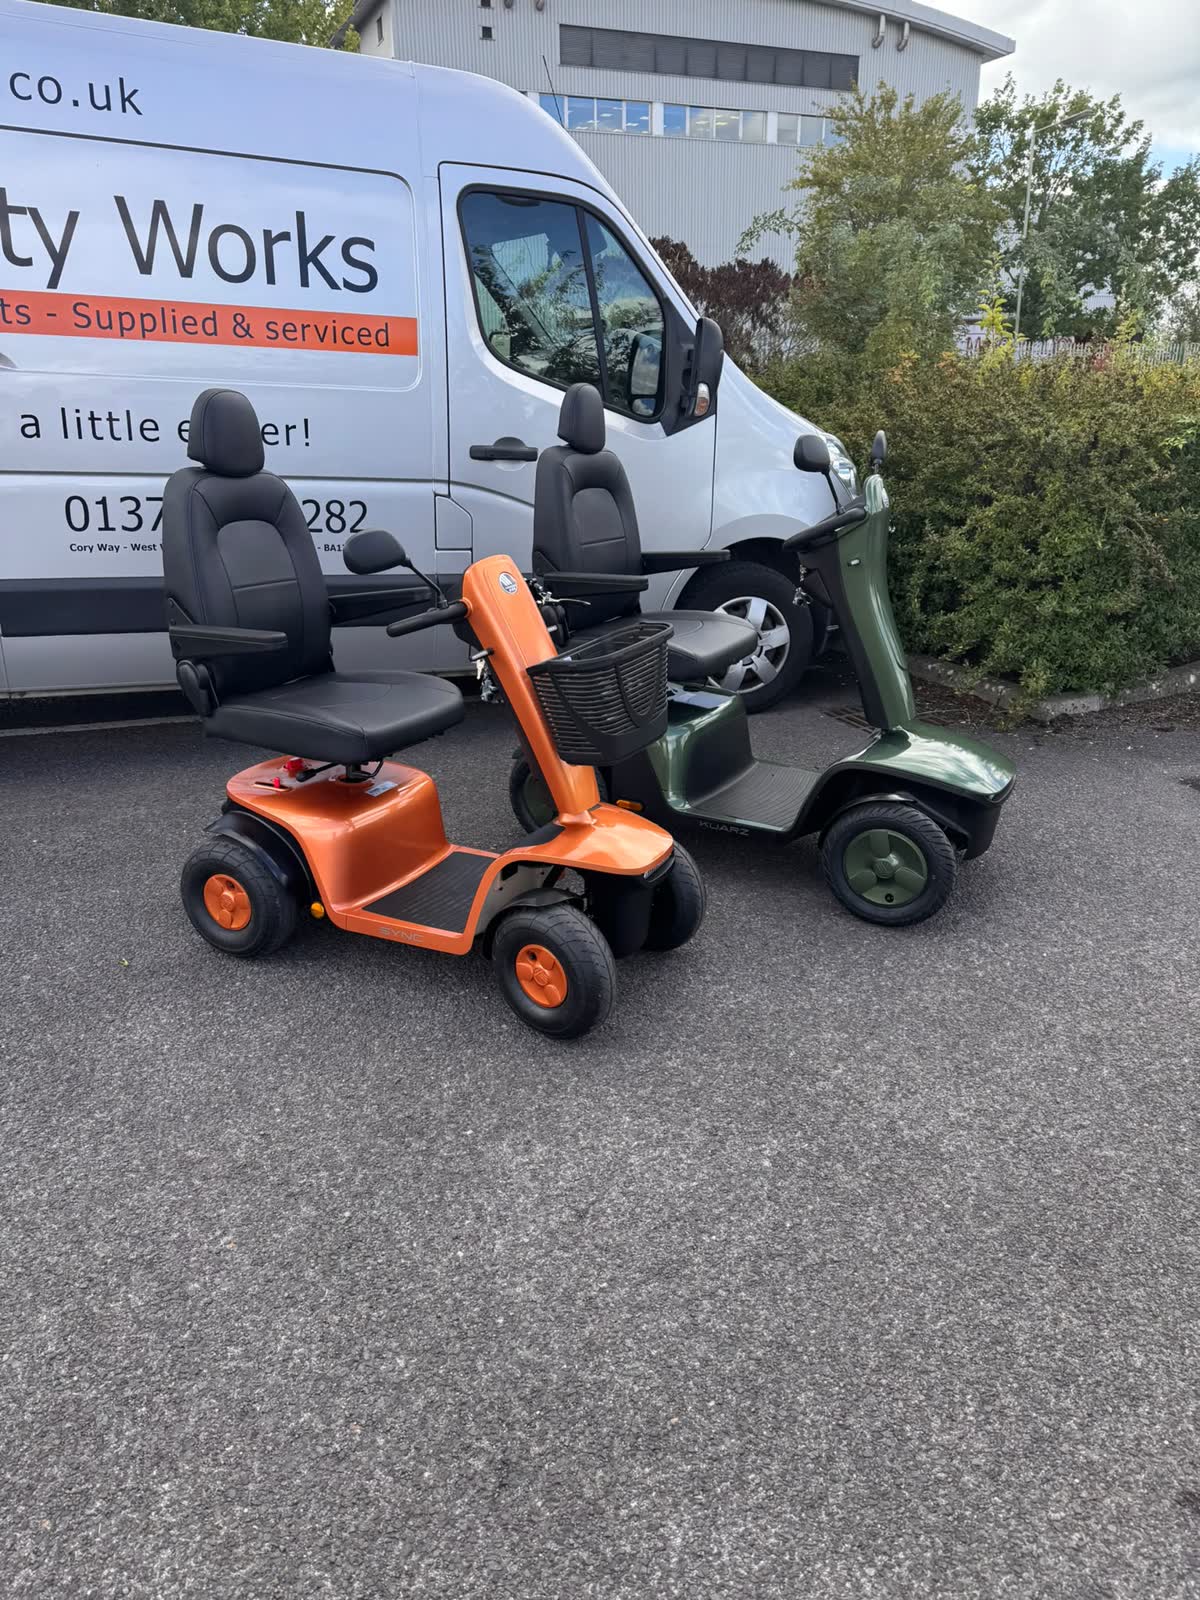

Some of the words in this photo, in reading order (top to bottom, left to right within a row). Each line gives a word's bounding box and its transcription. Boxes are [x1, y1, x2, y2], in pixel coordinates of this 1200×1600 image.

[114, 195, 379, 293] Works
[72, 301, 218, 338] Supplied
[232, 318, 254, 338] &
[266, 320, 390, 347] serviced
[20, 413, 41, 438] a
[61, 407, 160, 442] little
[69, 543, 94, 553] Cory
[97, 543, 120, 553] Way
[131, 543, 157, 552] West
